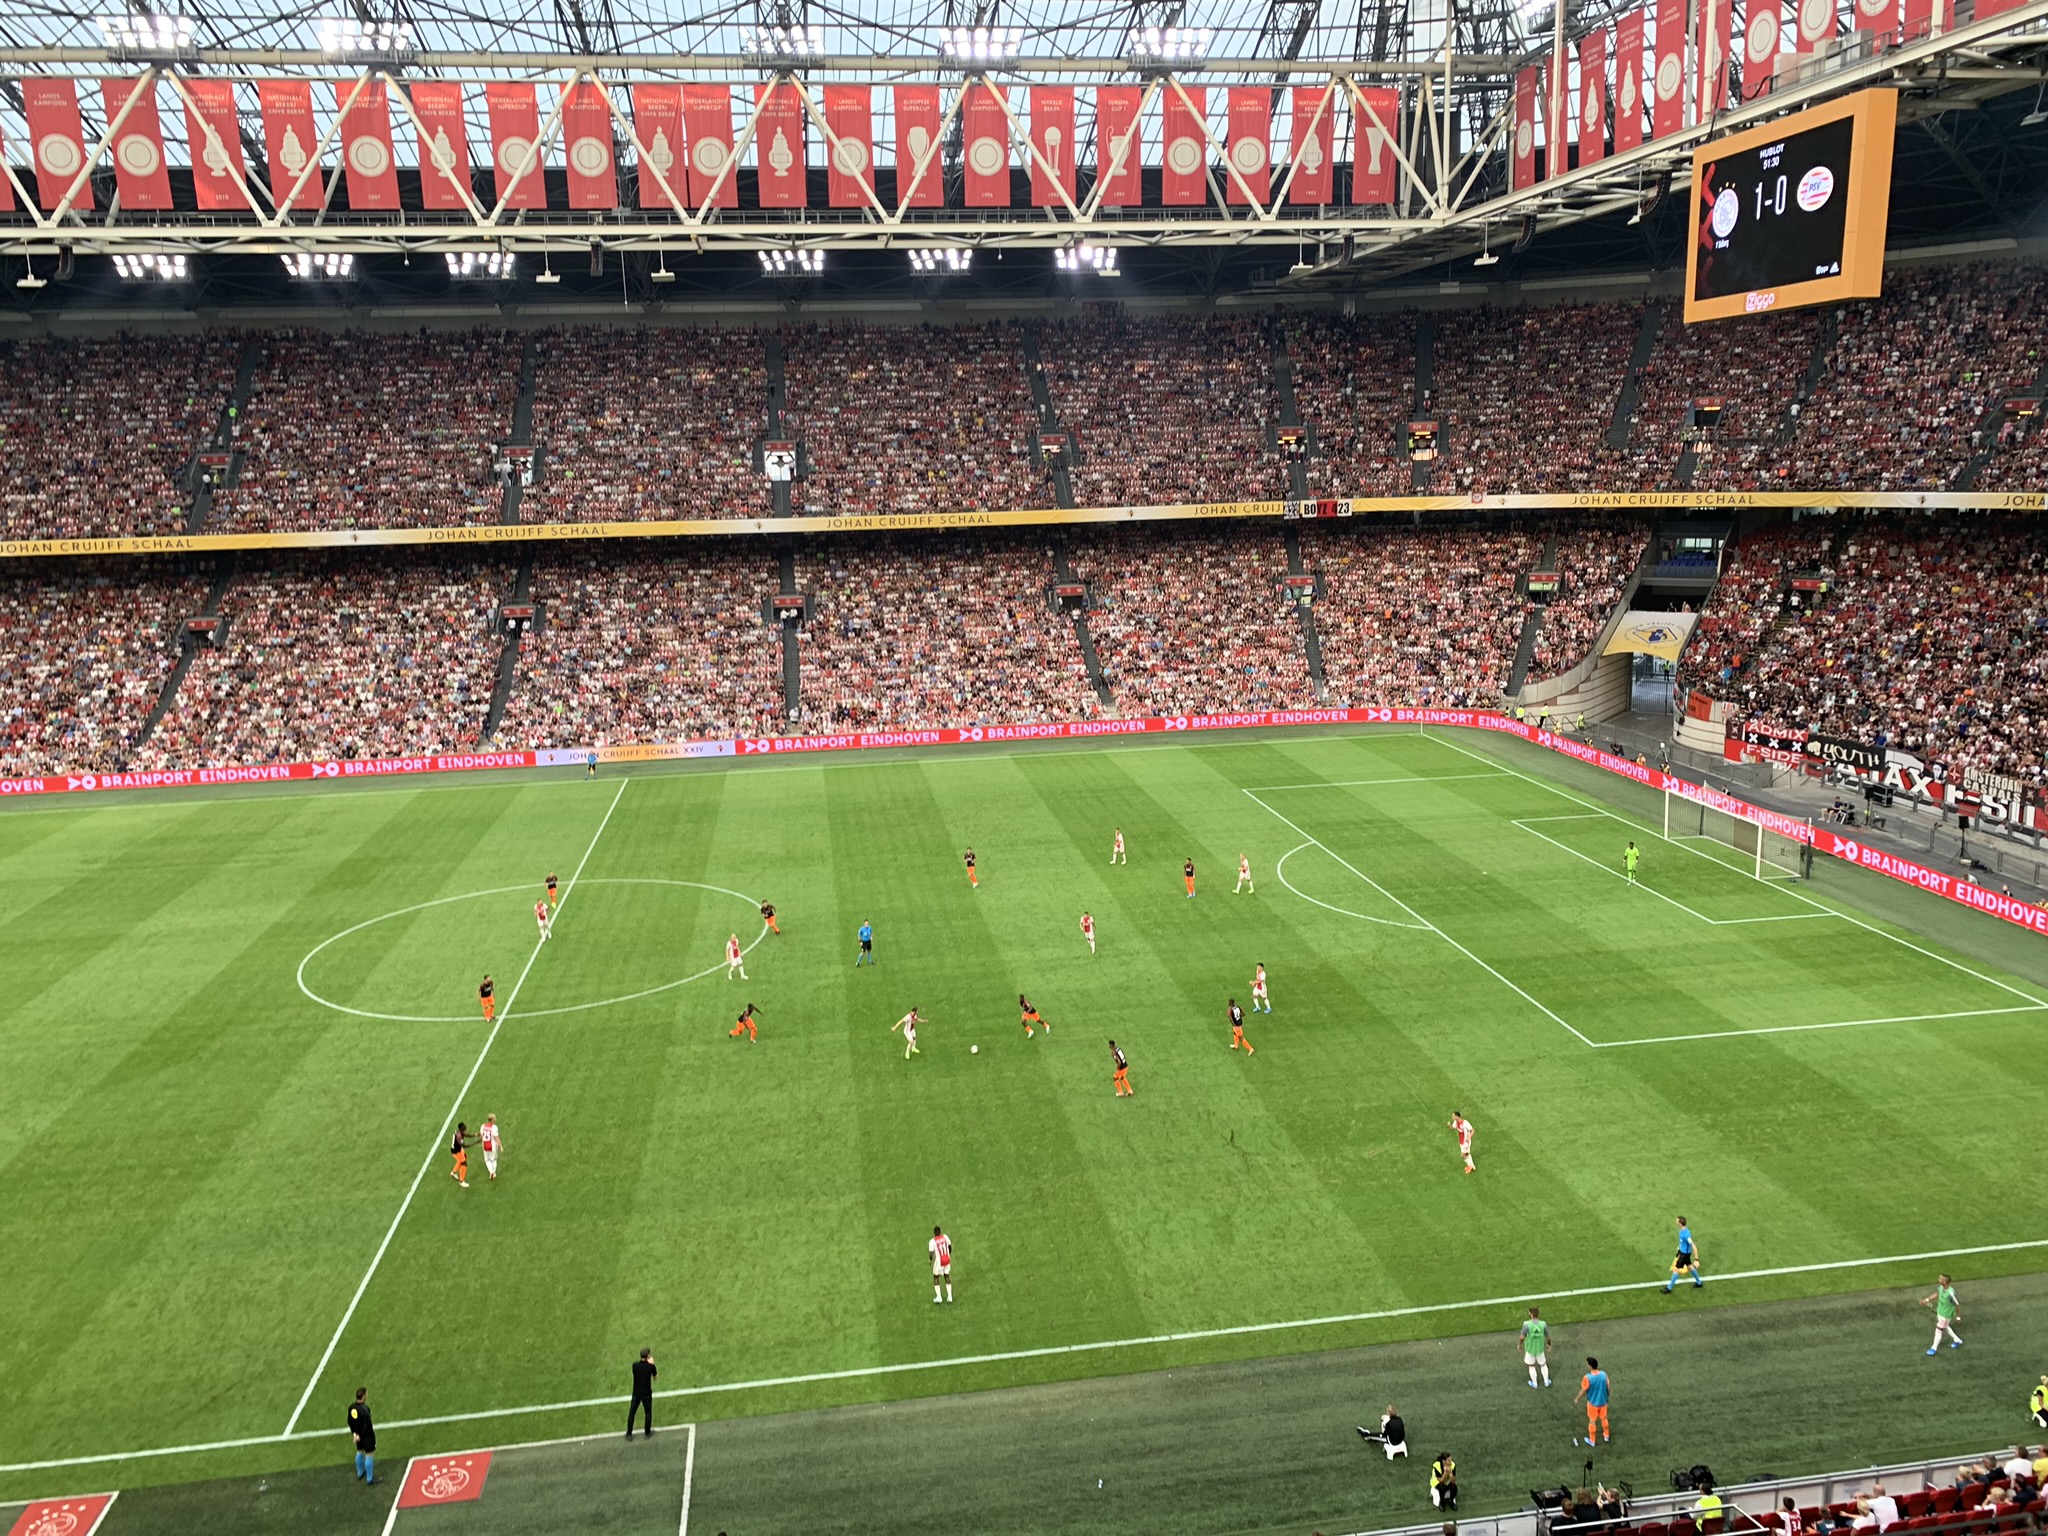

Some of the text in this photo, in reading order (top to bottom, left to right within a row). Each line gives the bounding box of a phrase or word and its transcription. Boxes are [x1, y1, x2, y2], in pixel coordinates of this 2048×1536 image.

[1760, 143, 1785, 159] HUBLOT
[1763, 157, 1780, 170] 51:30
[1808, 181, 1822, 192] PSV
[1304, 502, 1350, 515] BOYZ 423
[1572, 494, 1755, 505] JOHAN CRUIJFF SCHAAL
[1194, 503, 1281, 516] JOHAN CRUIJ
[826, 513, 993, 529] JOHAN CRUIJFF SCHAAL
[427, 525, 608, 541] JOHAN CRUIJFF SCHAAL
[0, 538, 194, 555] JOHAN CRUIJFF SCHAAL
[1192, 710, 1348, 728] BRAINPORT EINDHOVEN
[1397, 710, 1529, 737] BRAINPORT EINDHOVEN
[988, 719, 1146, 739] BRAINPORT EINDHOVEN
[1748, 722, 1808, 741] ADMIX
[774, 731, 940, 751] BRAINPORT EINDHOVEN
[603, 748, 643, 759] CRUIJFF
[645, 746, 680, 757] SCHAAL
[683, 745, 704, 755] XXIV
[1552, 735, 1650, 781] BRAINPORT EINDHOVEN
[1746, 745, 1803, 764] F-SIDE
[1822, 743, 1880, 767] YOUTH
[344, 753, 525, 774] BRAINPORT EINDHOVEN
[102, 766, 290, 788] BRAINPORT EINDHOVEN
[1963, 766, 2023, 793] AMSTERDAM
[1963, 779, 2022, 803] CASUALS
[1682, 783, 1816, 843] BRAINPORT EINDHOVEN
[1861, 848, 1950, 893] BRAINPORT
